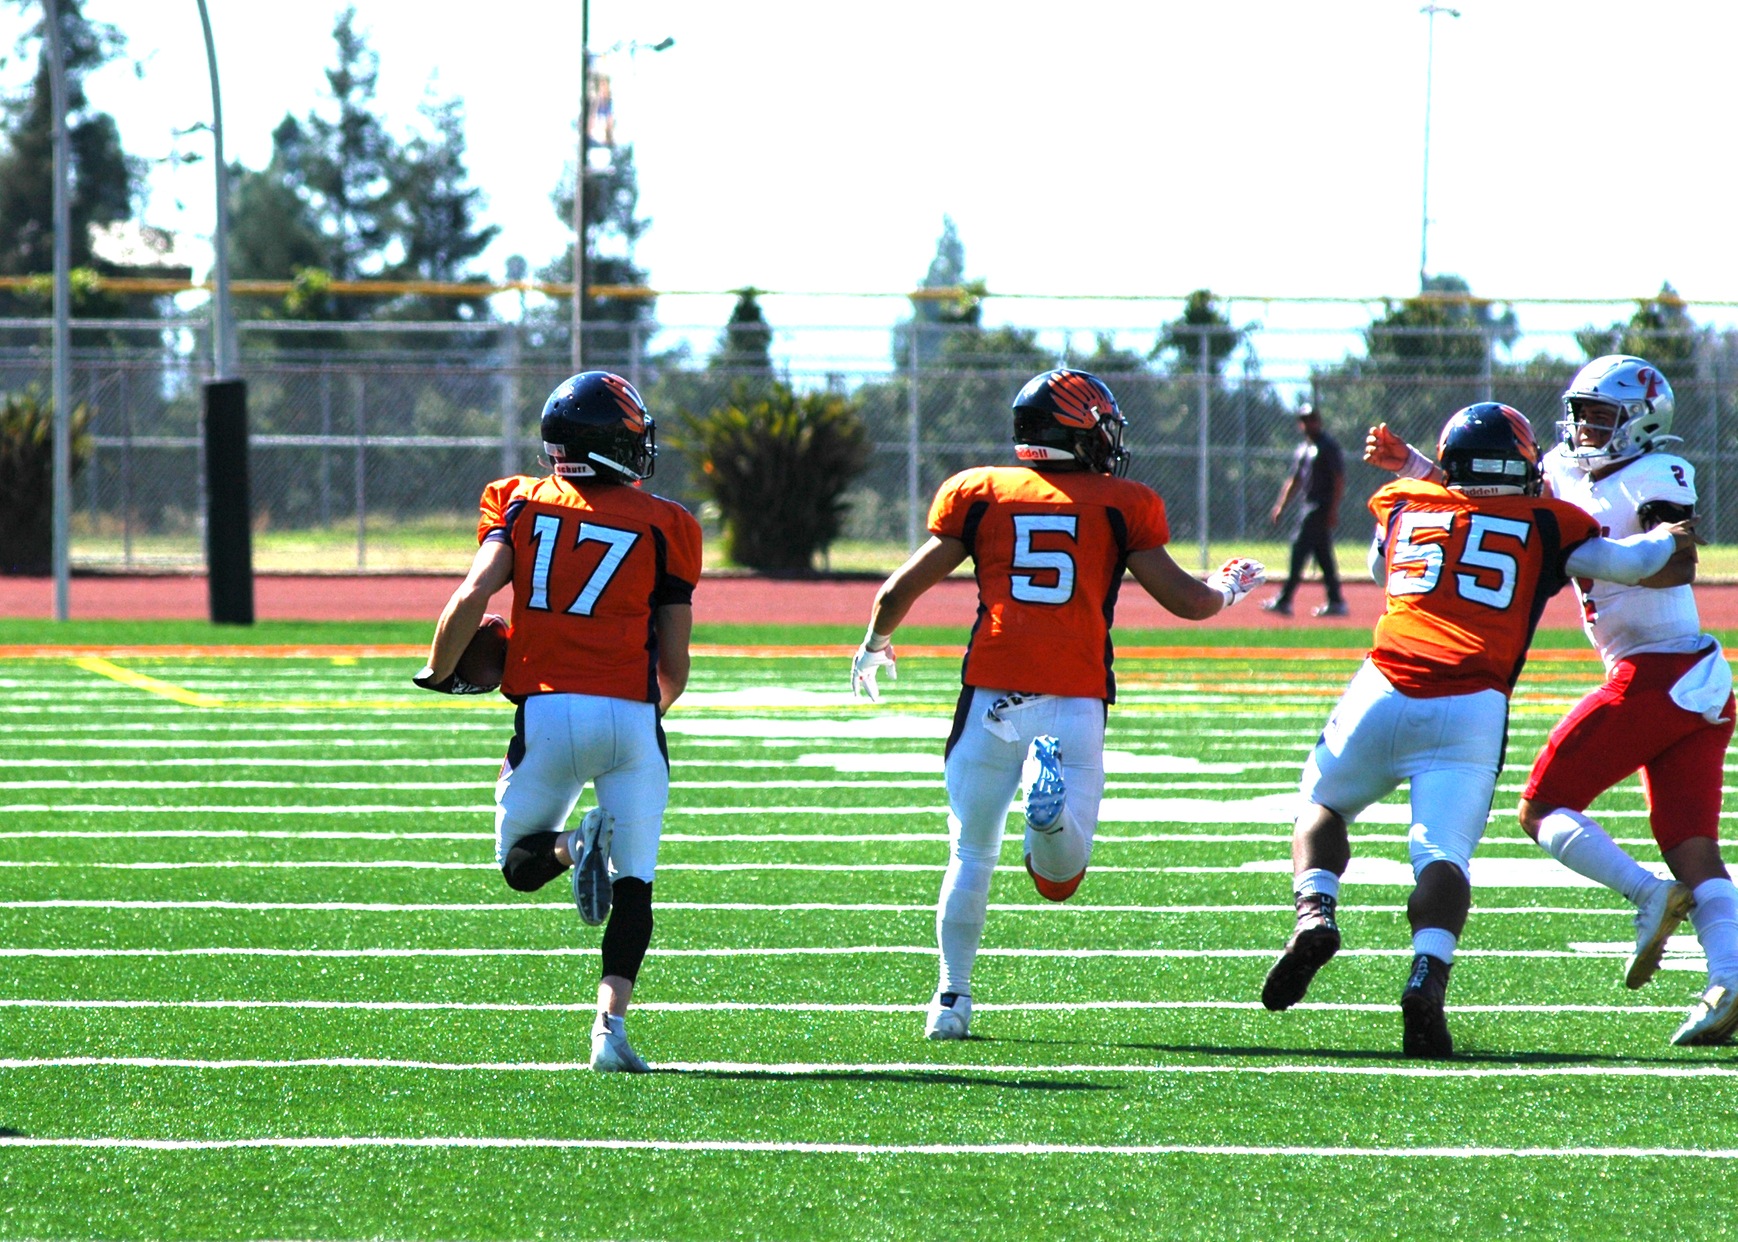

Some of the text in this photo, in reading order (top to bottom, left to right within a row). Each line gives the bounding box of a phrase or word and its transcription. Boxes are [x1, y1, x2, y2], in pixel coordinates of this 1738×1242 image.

[1671, 464, 1688, 488] 2
[526, 513, 643, 618] 17
[1009, 512, 1079, 606] 5
[1385, 509, 1534, 611] 55
